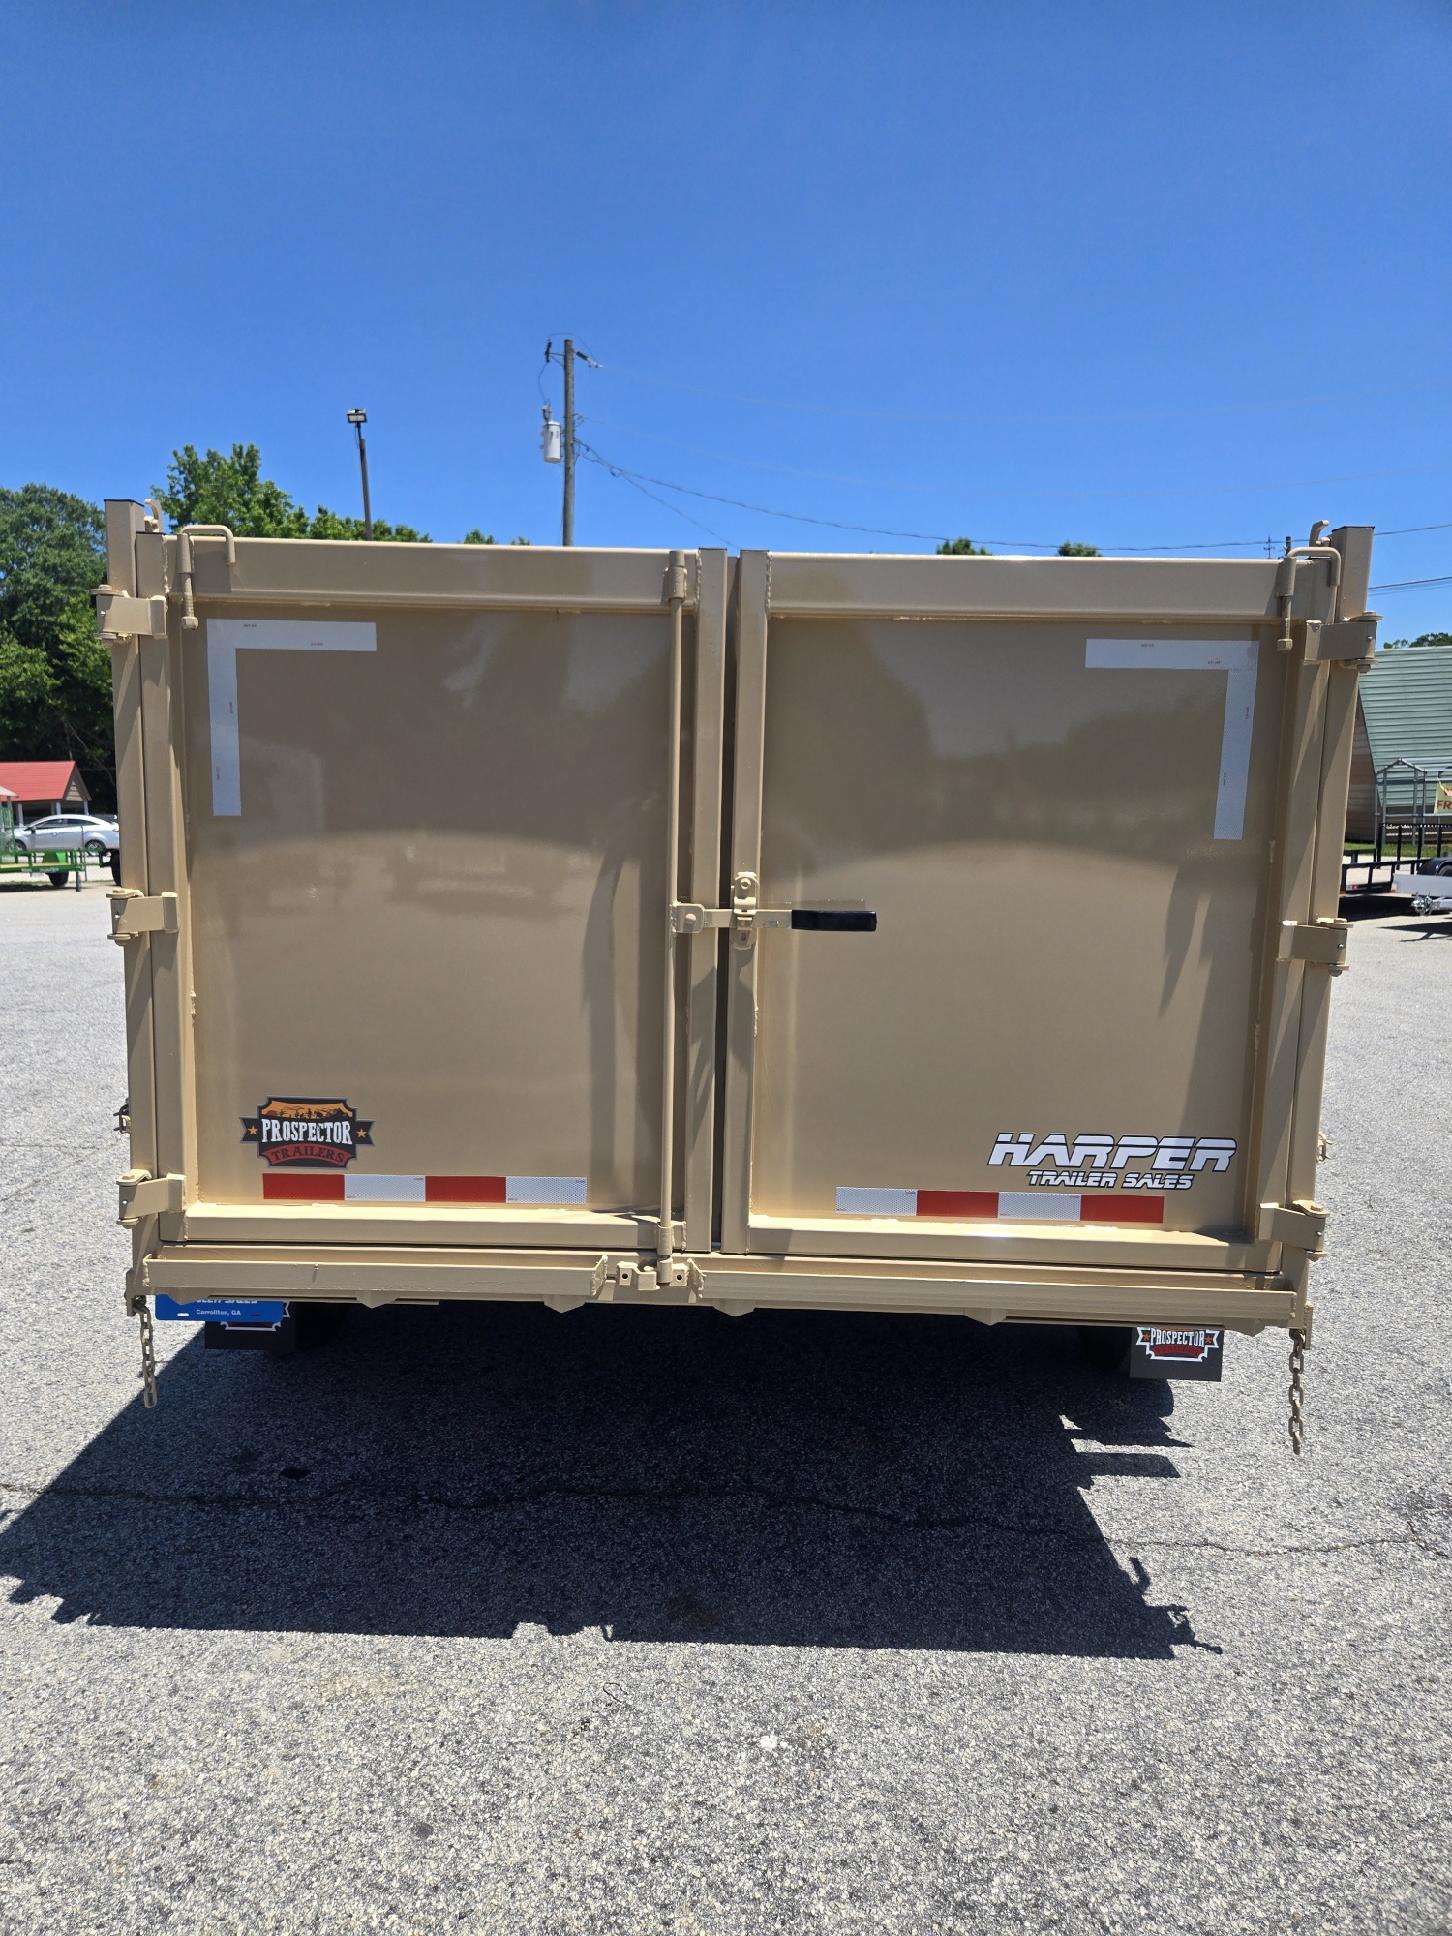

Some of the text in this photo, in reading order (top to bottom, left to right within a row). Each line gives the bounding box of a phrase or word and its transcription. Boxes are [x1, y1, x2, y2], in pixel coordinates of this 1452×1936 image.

[261, 1118, 352, 1145] PROSPECTOR
[270, 1145, 345, 1163] TRAILERS
[988, 1133, 1237, 1172] HARPER
[1027, 1170, 1195, 1191] TRAILER SALES
[1150, 1328, 1205, 1348] PROSPECTOR
